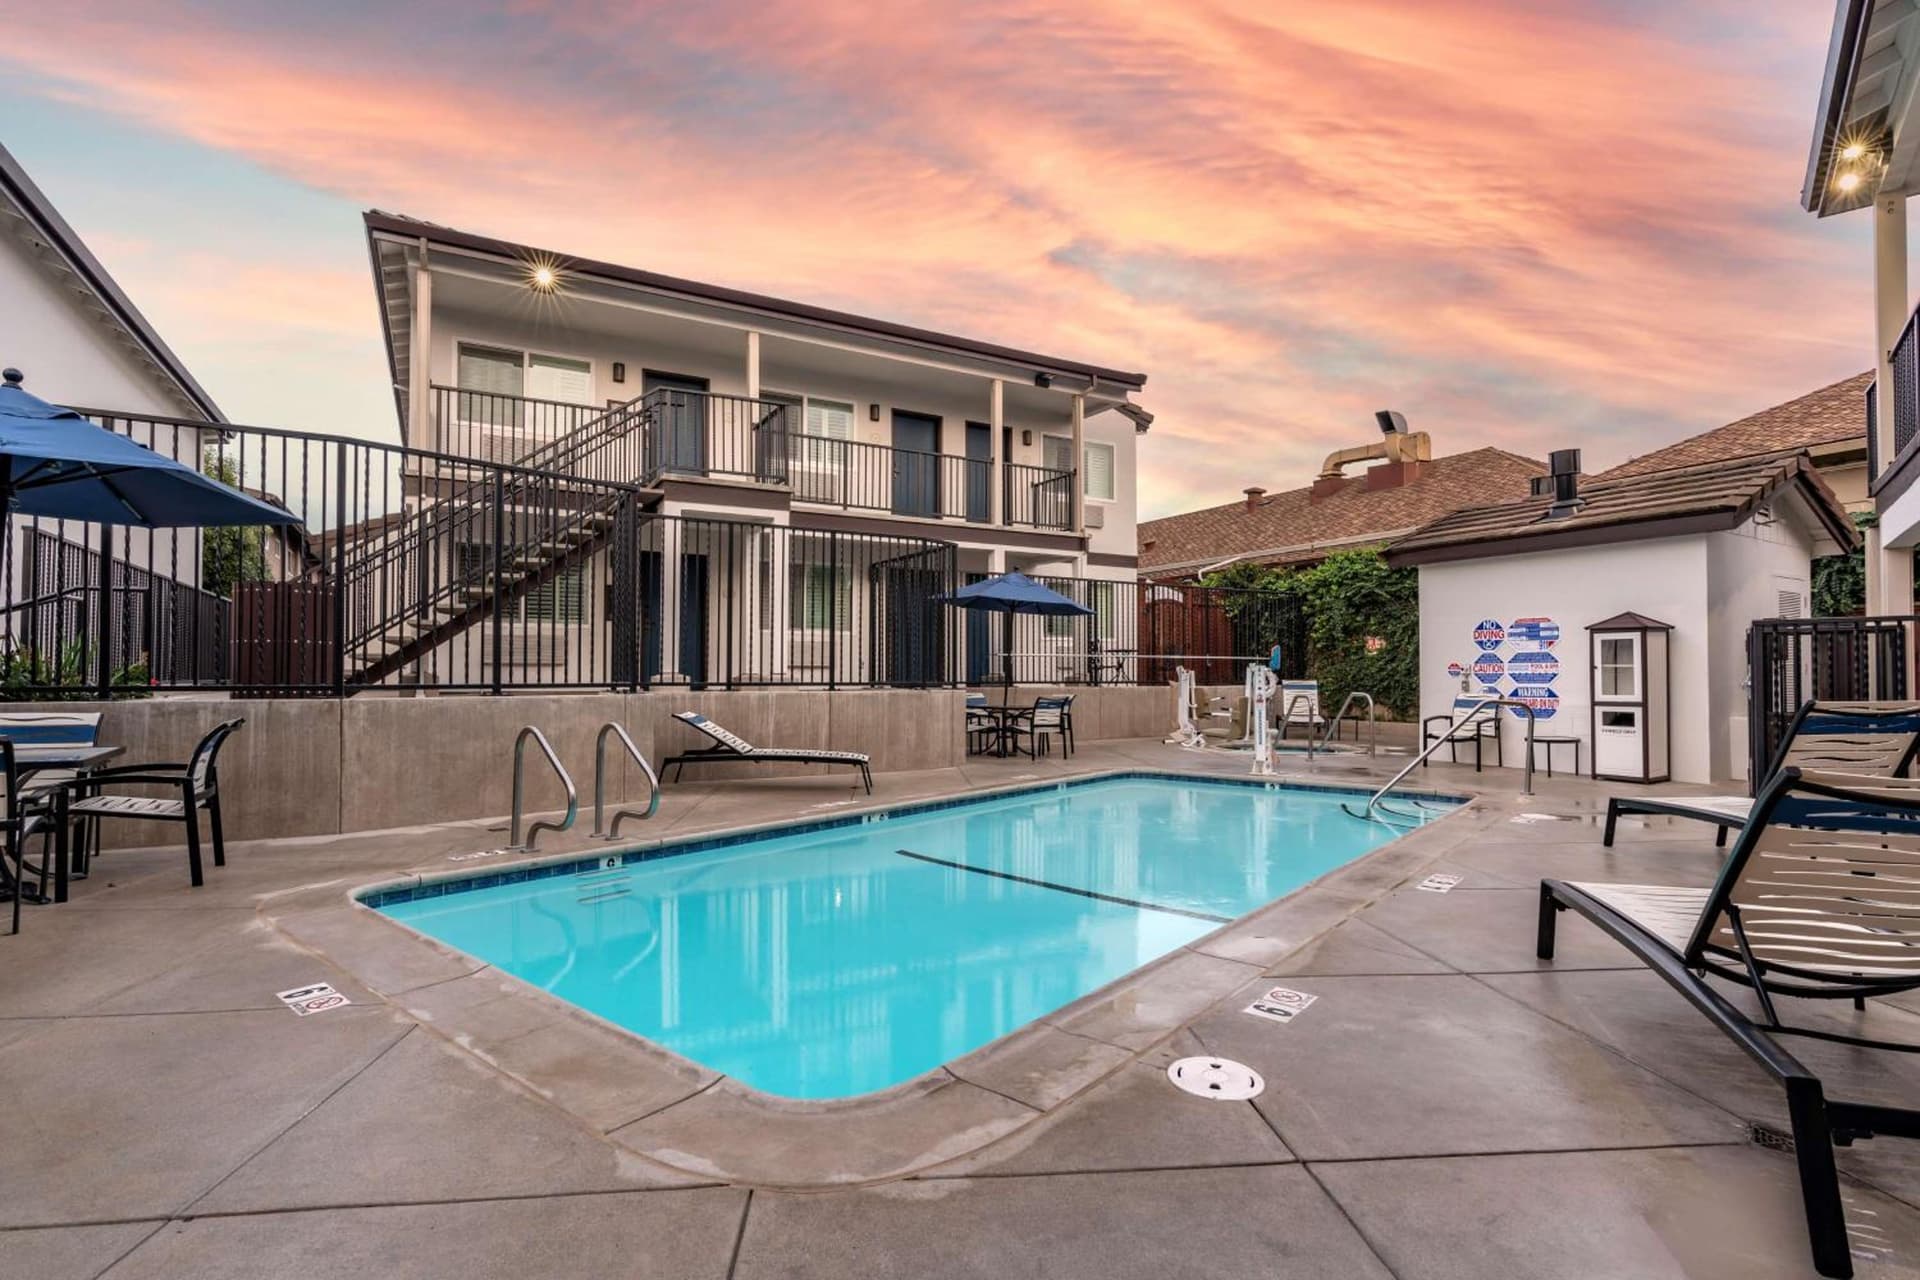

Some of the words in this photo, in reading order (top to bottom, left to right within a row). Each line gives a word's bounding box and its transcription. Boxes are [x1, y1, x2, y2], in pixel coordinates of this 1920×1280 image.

[1483, 620, 1495, 630] NO
[1473, 630, 1504, 640] DIVING
[1472, 664, 1504, 673] CAUTION
[1517, 687, 1549, 698] WARNING
